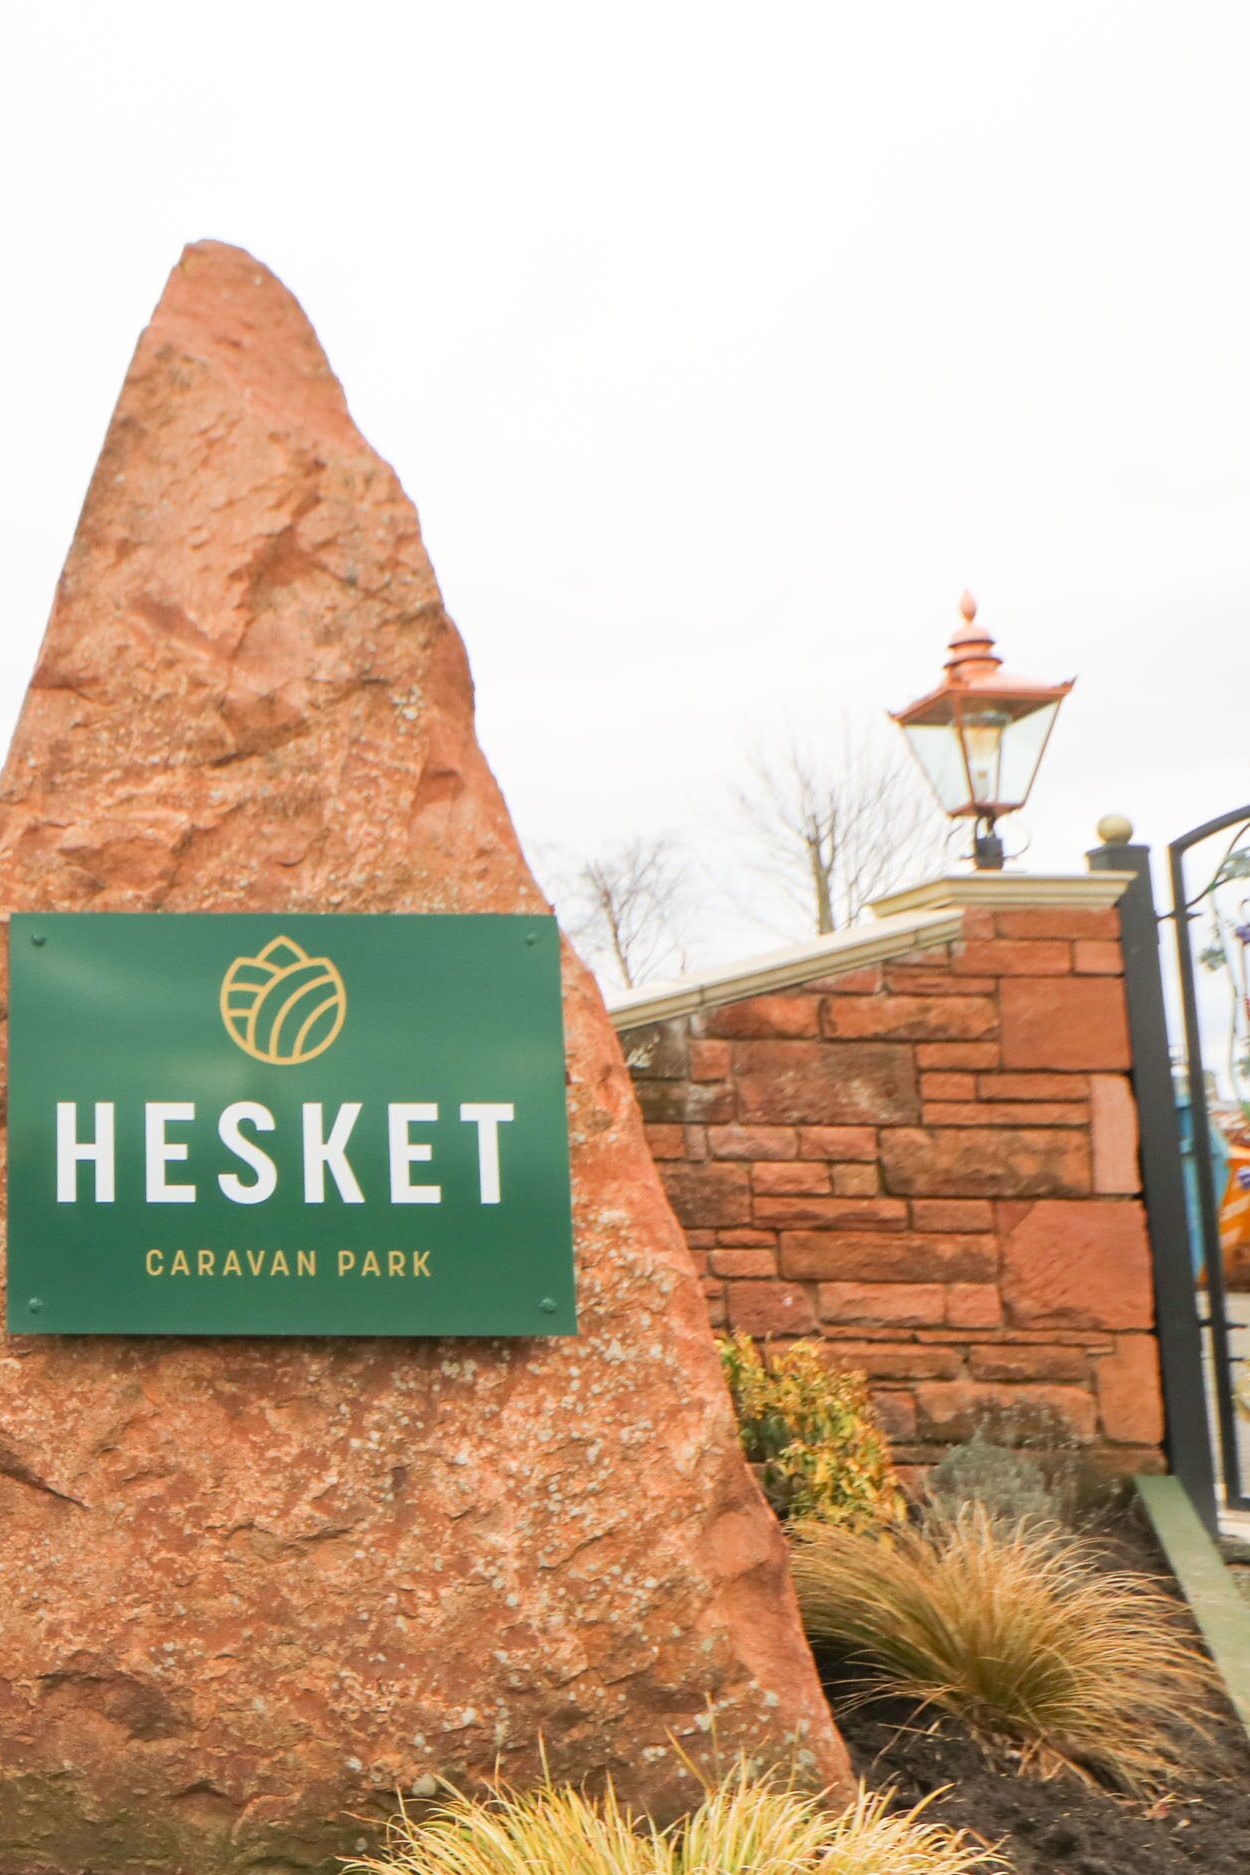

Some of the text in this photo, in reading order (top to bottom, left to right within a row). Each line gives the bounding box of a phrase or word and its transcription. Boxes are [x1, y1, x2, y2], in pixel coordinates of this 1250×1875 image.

[56, 1101, 515, 1205] HESKET
[145, 1248, 432, 1277] CARAVAN PARK
